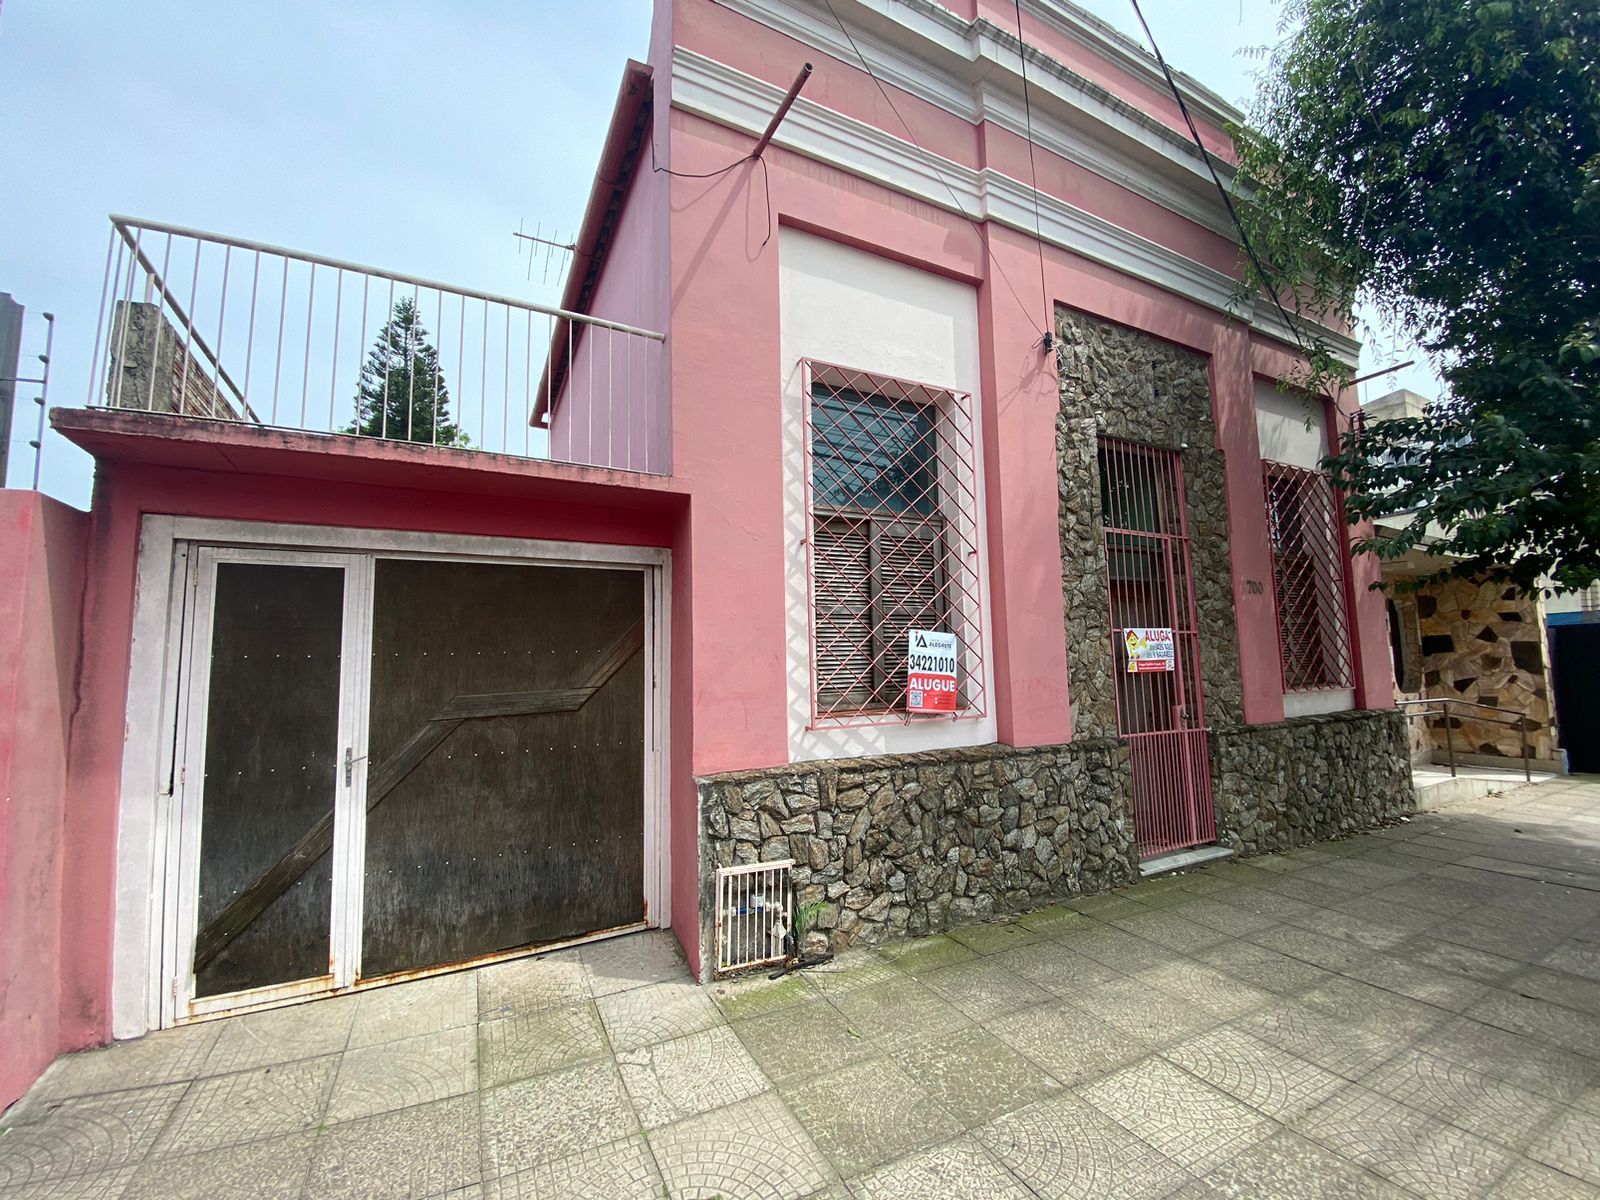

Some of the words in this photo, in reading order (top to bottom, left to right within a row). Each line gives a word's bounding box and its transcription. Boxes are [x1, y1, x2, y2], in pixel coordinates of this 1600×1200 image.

[1246, 580, 1264, 594] 700
[1145, 630, 1171, 642] ALUGA
[909, 654, 955, 673] 34221010
[909, 677, 955, 692] ALUGUE
